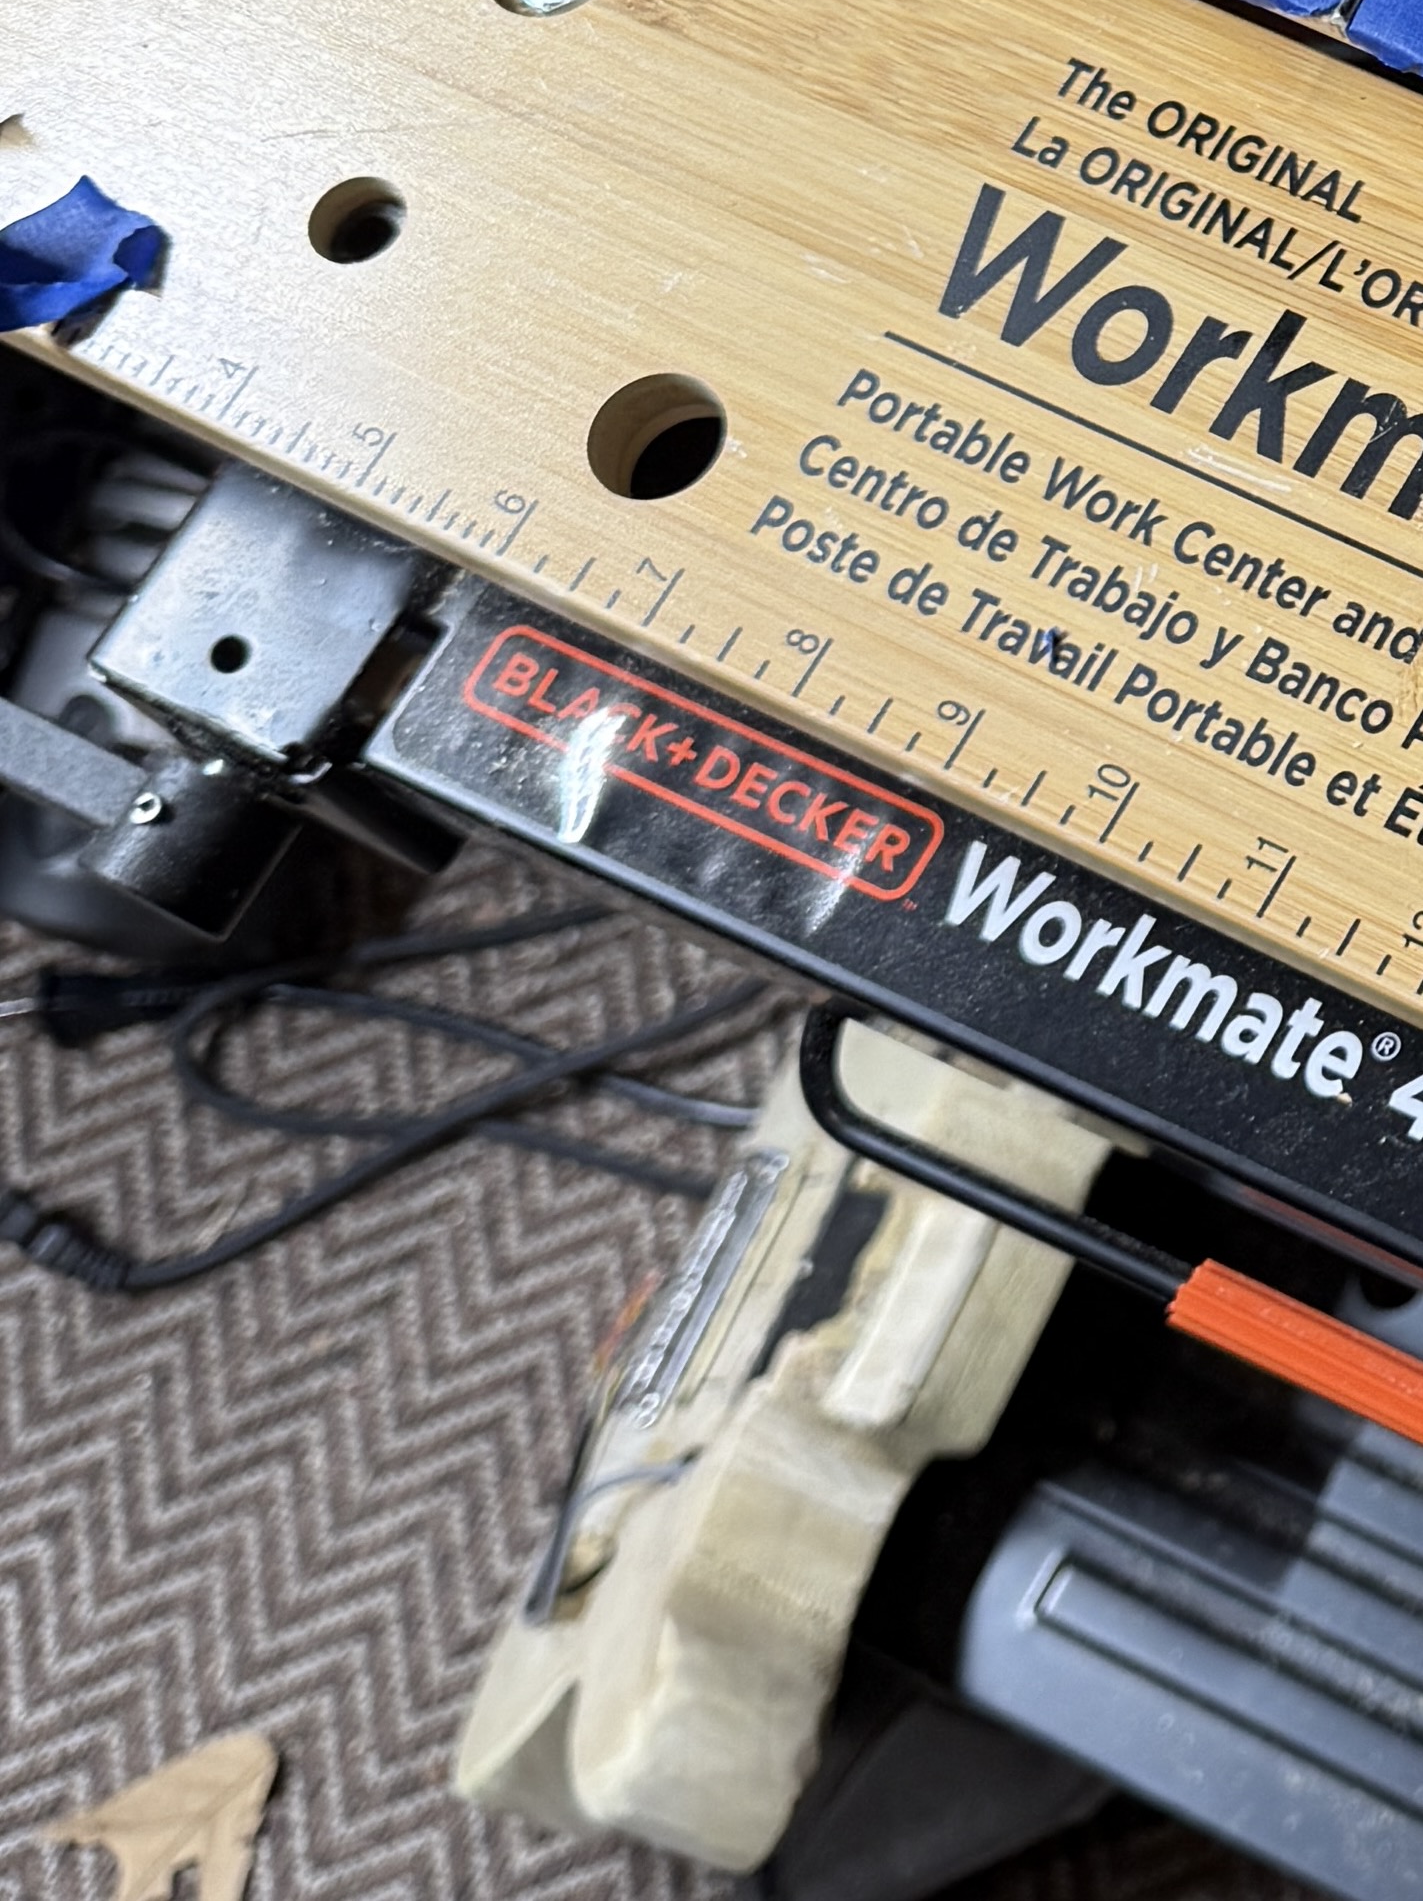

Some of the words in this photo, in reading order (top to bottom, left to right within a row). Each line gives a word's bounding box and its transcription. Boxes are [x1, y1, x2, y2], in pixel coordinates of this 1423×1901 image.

[1010, 115, 1070, 169] La
[1057, 56, 1138, 121] The
[1146, 100, 1365, 224] ORIGINAL
[799, 434, 948, 530] Centro
[957, 509, 1018, 562] de
[1030, 534, 1199, 645] Trabajo
[1198, 625, 1245, 669] y
[1244, 636, 1394, 735] Banco
[836, 368, 1030, 484] Portable
[1042, 456, 1169, 547] Work
[1173, 520, 1332, 617] Center
[749, 495, 878, 583] Poste
[887, 563, 949, 616] de
[961, 587, 1118, 692] Travail
[1113, 662, 1317, 787] Portable
[1325, 770, 1382, 817] et
[785, 628, 820, 655] 8
